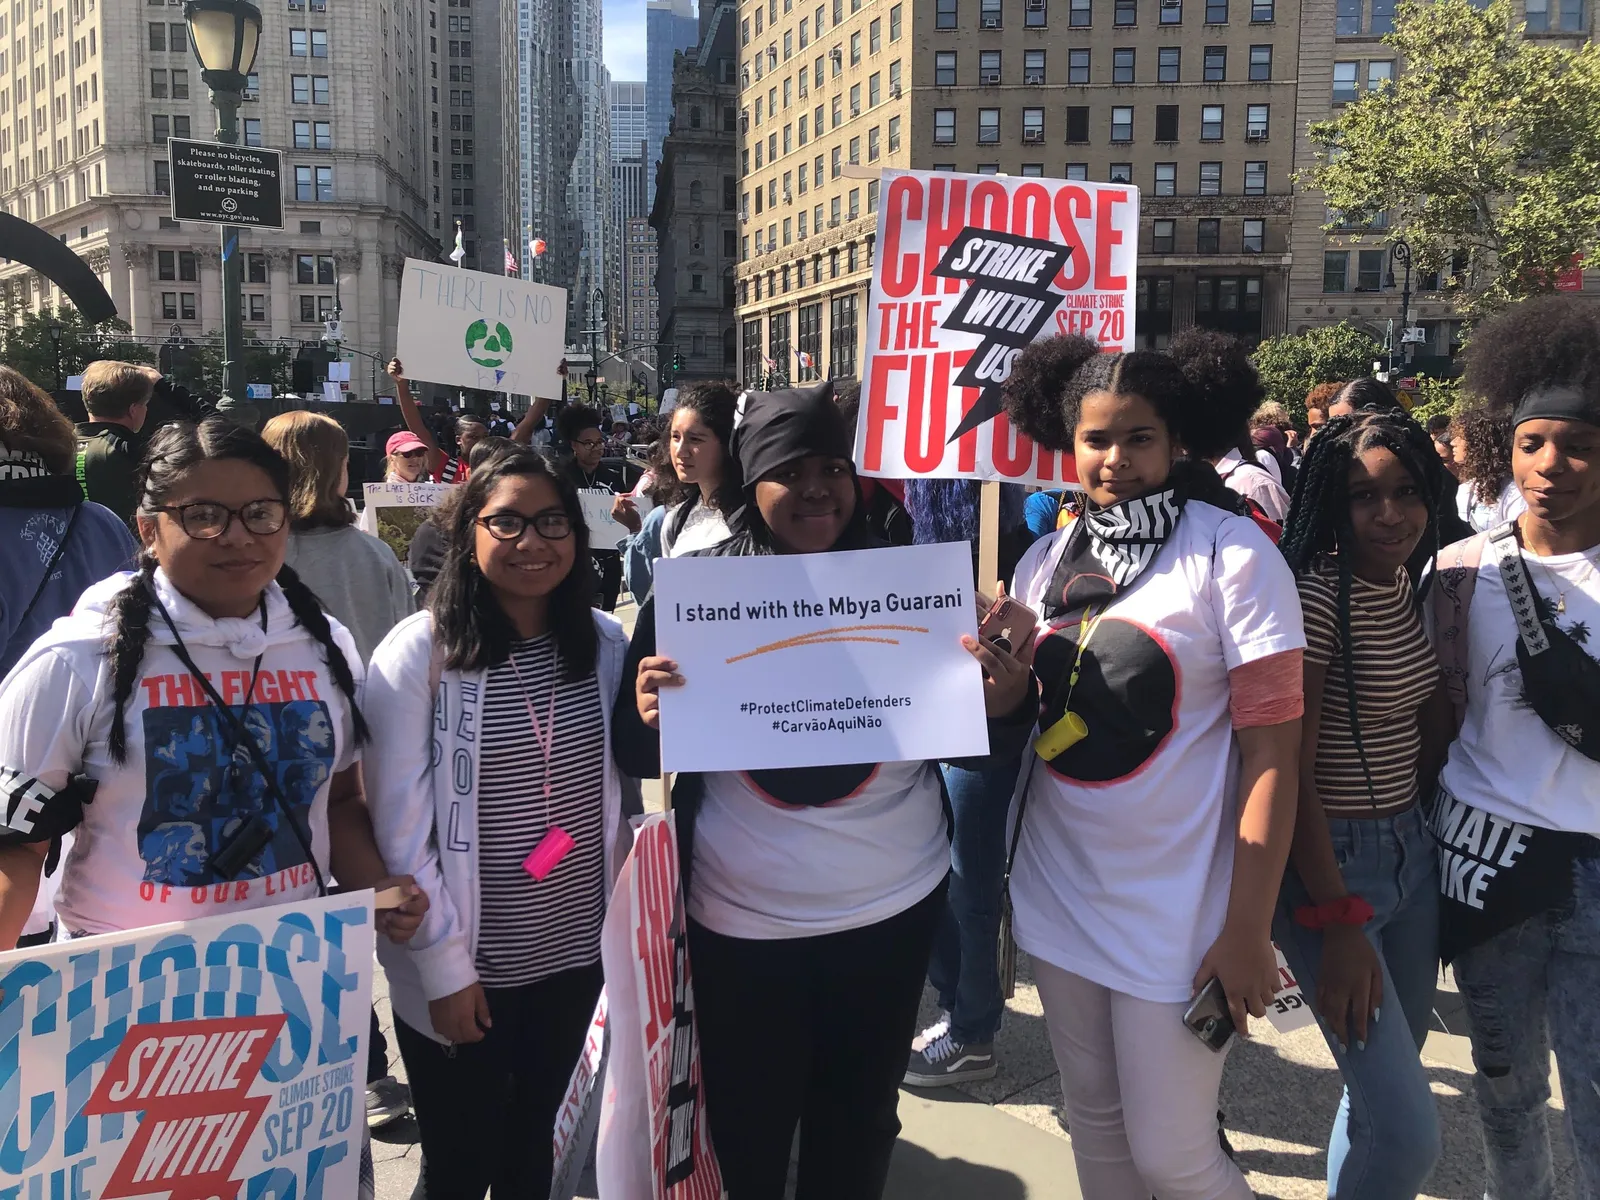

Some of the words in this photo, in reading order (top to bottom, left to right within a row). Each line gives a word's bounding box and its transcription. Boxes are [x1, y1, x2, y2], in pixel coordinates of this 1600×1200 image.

[177, 159, 226, 171] skateboards,
[227, 164, 247, 173] roller
[248, 166, 276, 177] skating
[190, 148, 216, 158] Please
[229, 153, 262, 164] bicycles,
[197, 184, 213, 192] and
[227, 187, 259, 198] parking
[204, 173, 227, 182] roller
[228, 175, 261, 187] blading,
[951, 237, 1057, 285] STRIKE
[411, 267, 488, 312] THERE
[498, 288, 517, 319] IS
[525, 294, 552, 325] NO
[962, 288, 1046, 334] WITH
[1066, 294, 1098, 309] CLIMATE
[1099, 294, 1125, 309] STRIKE
[878, 300, 942, 351] THE
[1055, 309, 1094, 339] SEP
[1097, 309, 1125, 342] 20
[386, 484, 404, 493] LAKE
[675, 603, 681, 623] I
[686, 601, 741, 622] stand
[746, 599, 788, 620] with
[793, 599, 824, 618] the
[829, 596, 881, 620] Mbya
[886, 588, 962, 611] Guarani
[141, 672, 217, 708] THE
[221, 669, 320, 705] FIGHT
[740, 694, 911, 716] #ProtectClimateDefenders
[772, 715, 882, 733] #CarvãoAquiNão
[139, 880, 173, 904] OF
[190, 880, 250, 905] OUR
[108, 1029, 267, 1102] STRIKE
[279, 1074, 321, 1109] CLIMATE
[322, 1062, 355, 1093] STRIKE
[262, 1101, 314, 1163] SEP
[319, 1086, 353, 1141] 20
[131, 1110, 251, 1184] WITH
